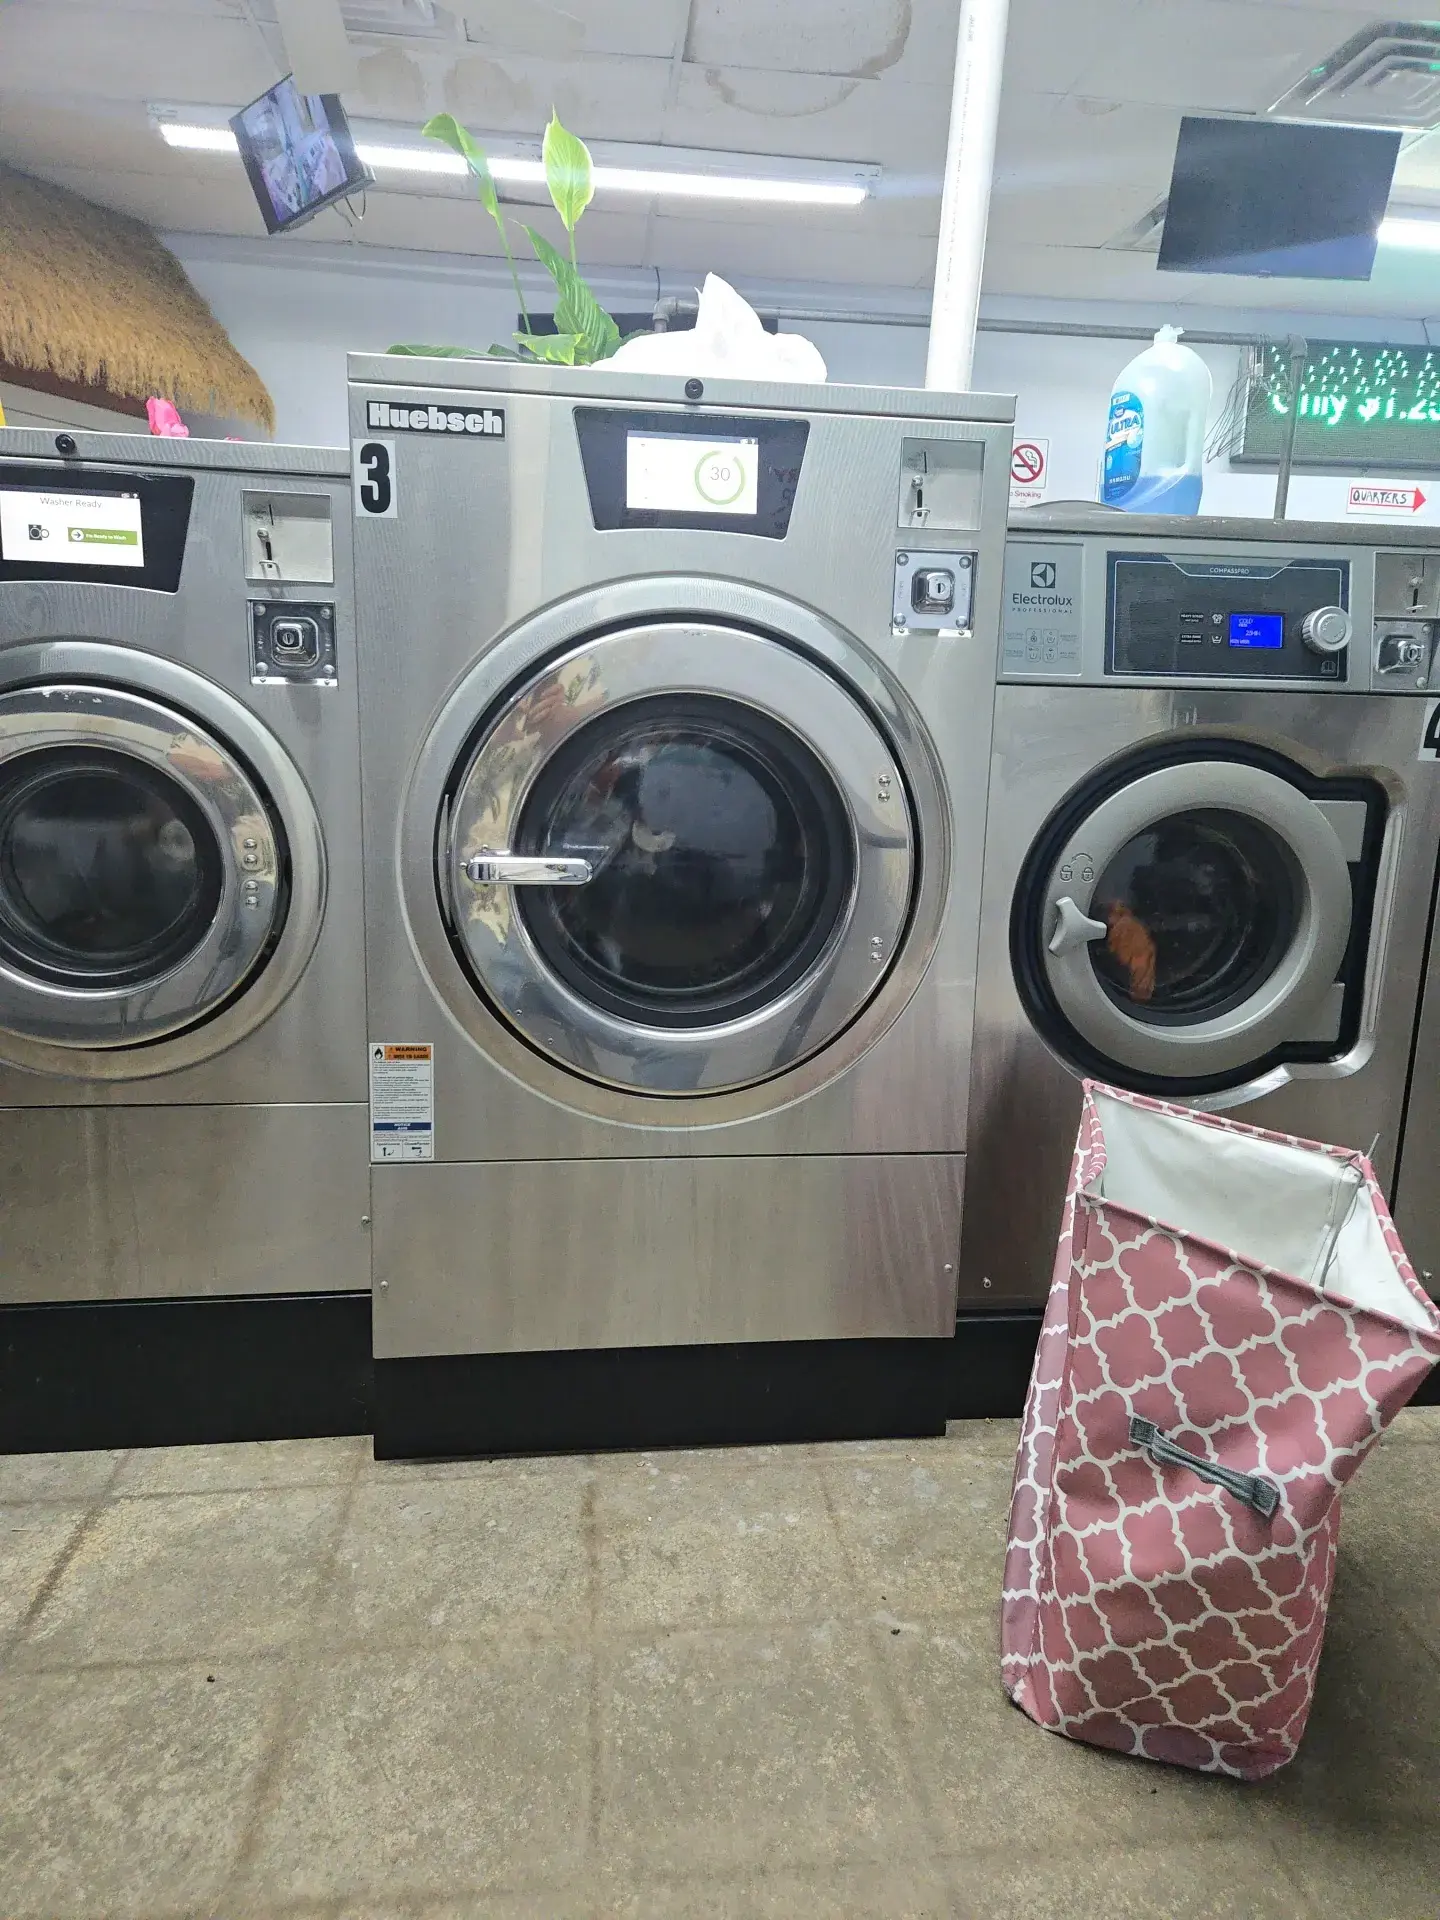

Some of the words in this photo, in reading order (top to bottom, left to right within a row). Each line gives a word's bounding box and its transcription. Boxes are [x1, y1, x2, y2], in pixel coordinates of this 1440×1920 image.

[369, 402, 503, 434] Huebsch
[1110, 414, 1140, 435] ULTRA
[360, 443, 392, 514] 3
[710, 466, 731, 481] 30
[1014, 490, 1042, 499] Smoking
[1353, 490, 1407, 504] QUARTERS
[40, 497, 73, 505] Washer
[75, 499, 102, 508] Ready
[1210, 567, 1250, 575] COMPASSPRO
[1012, 593, 1073, 606] Electrolux
